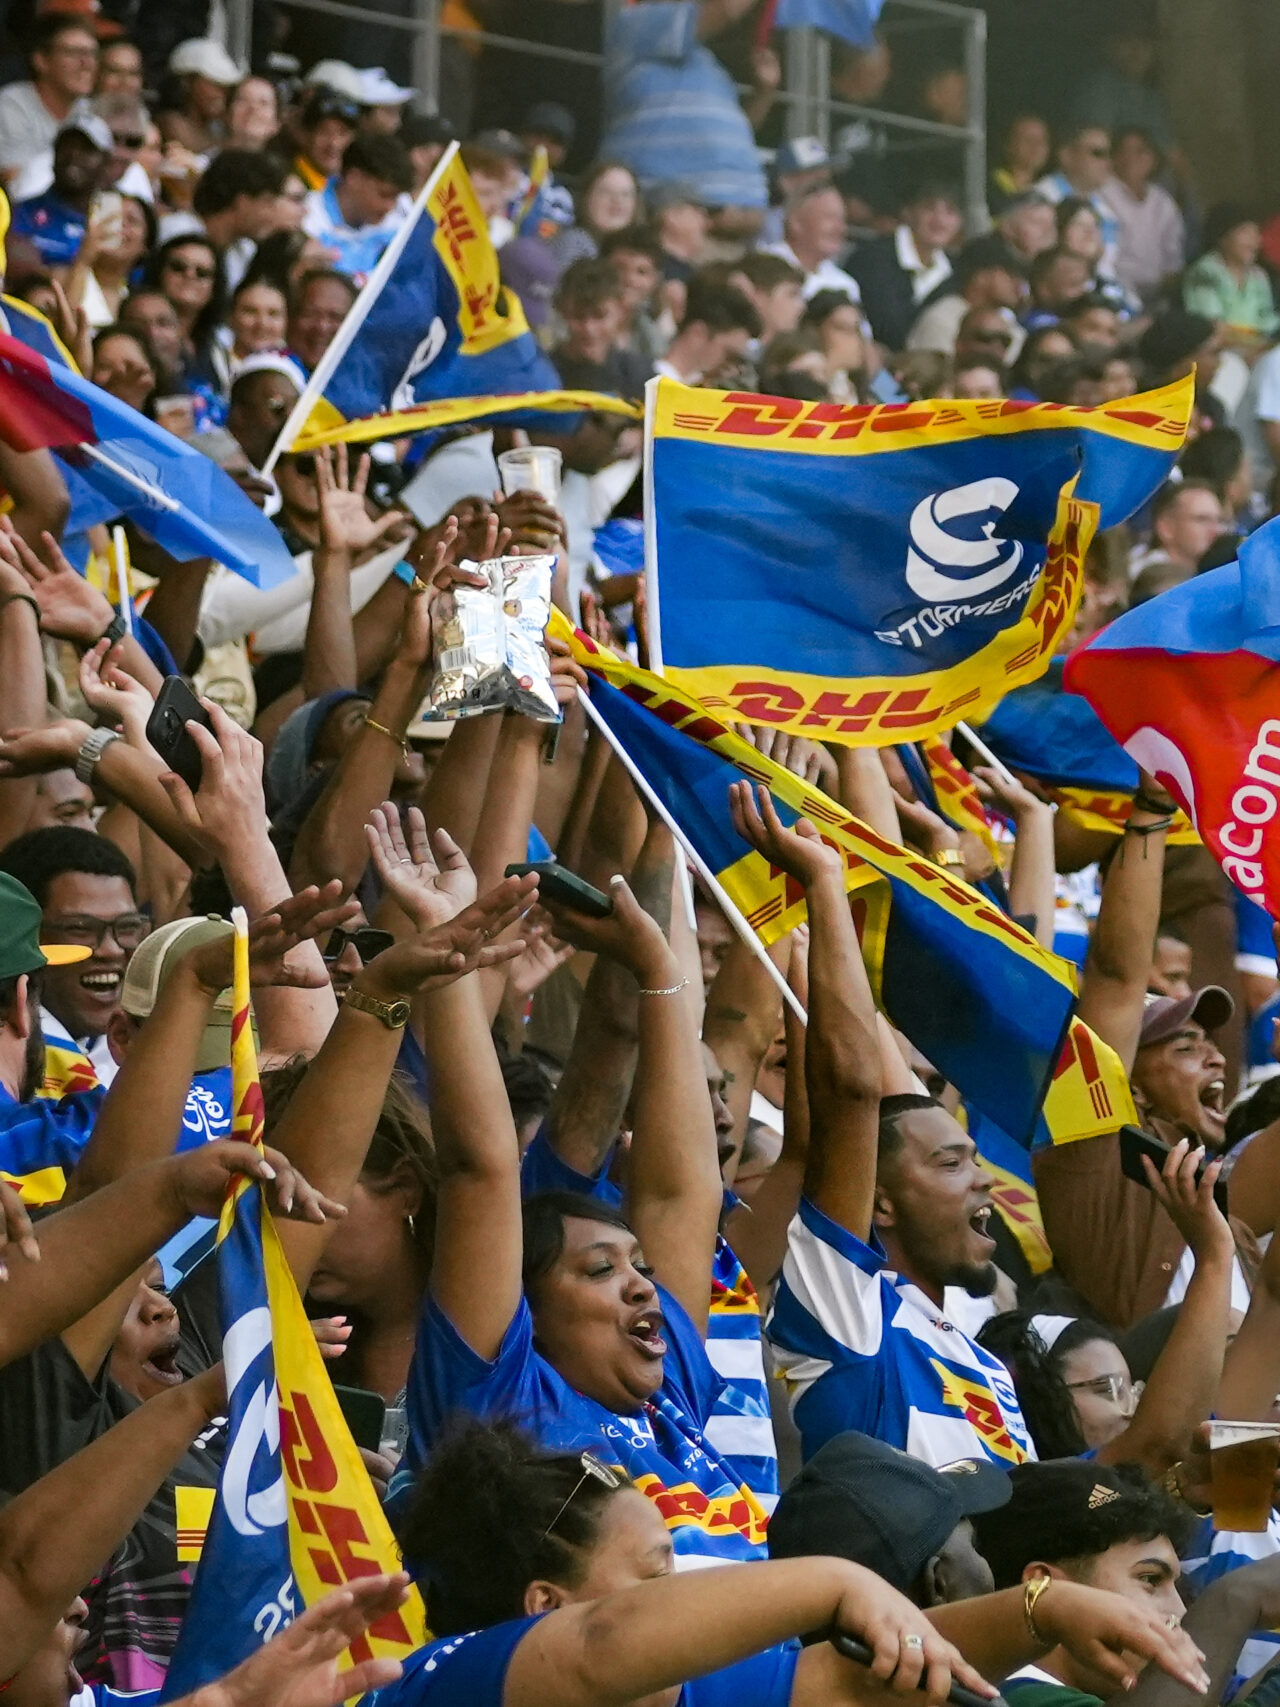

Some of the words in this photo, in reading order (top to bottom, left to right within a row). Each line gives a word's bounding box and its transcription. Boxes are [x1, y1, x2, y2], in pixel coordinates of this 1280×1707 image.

[714, 392, 936, 440] DHL
[729, 682, 944, 732] DHL
[1088, 1491, 1122, 1509] adidas
